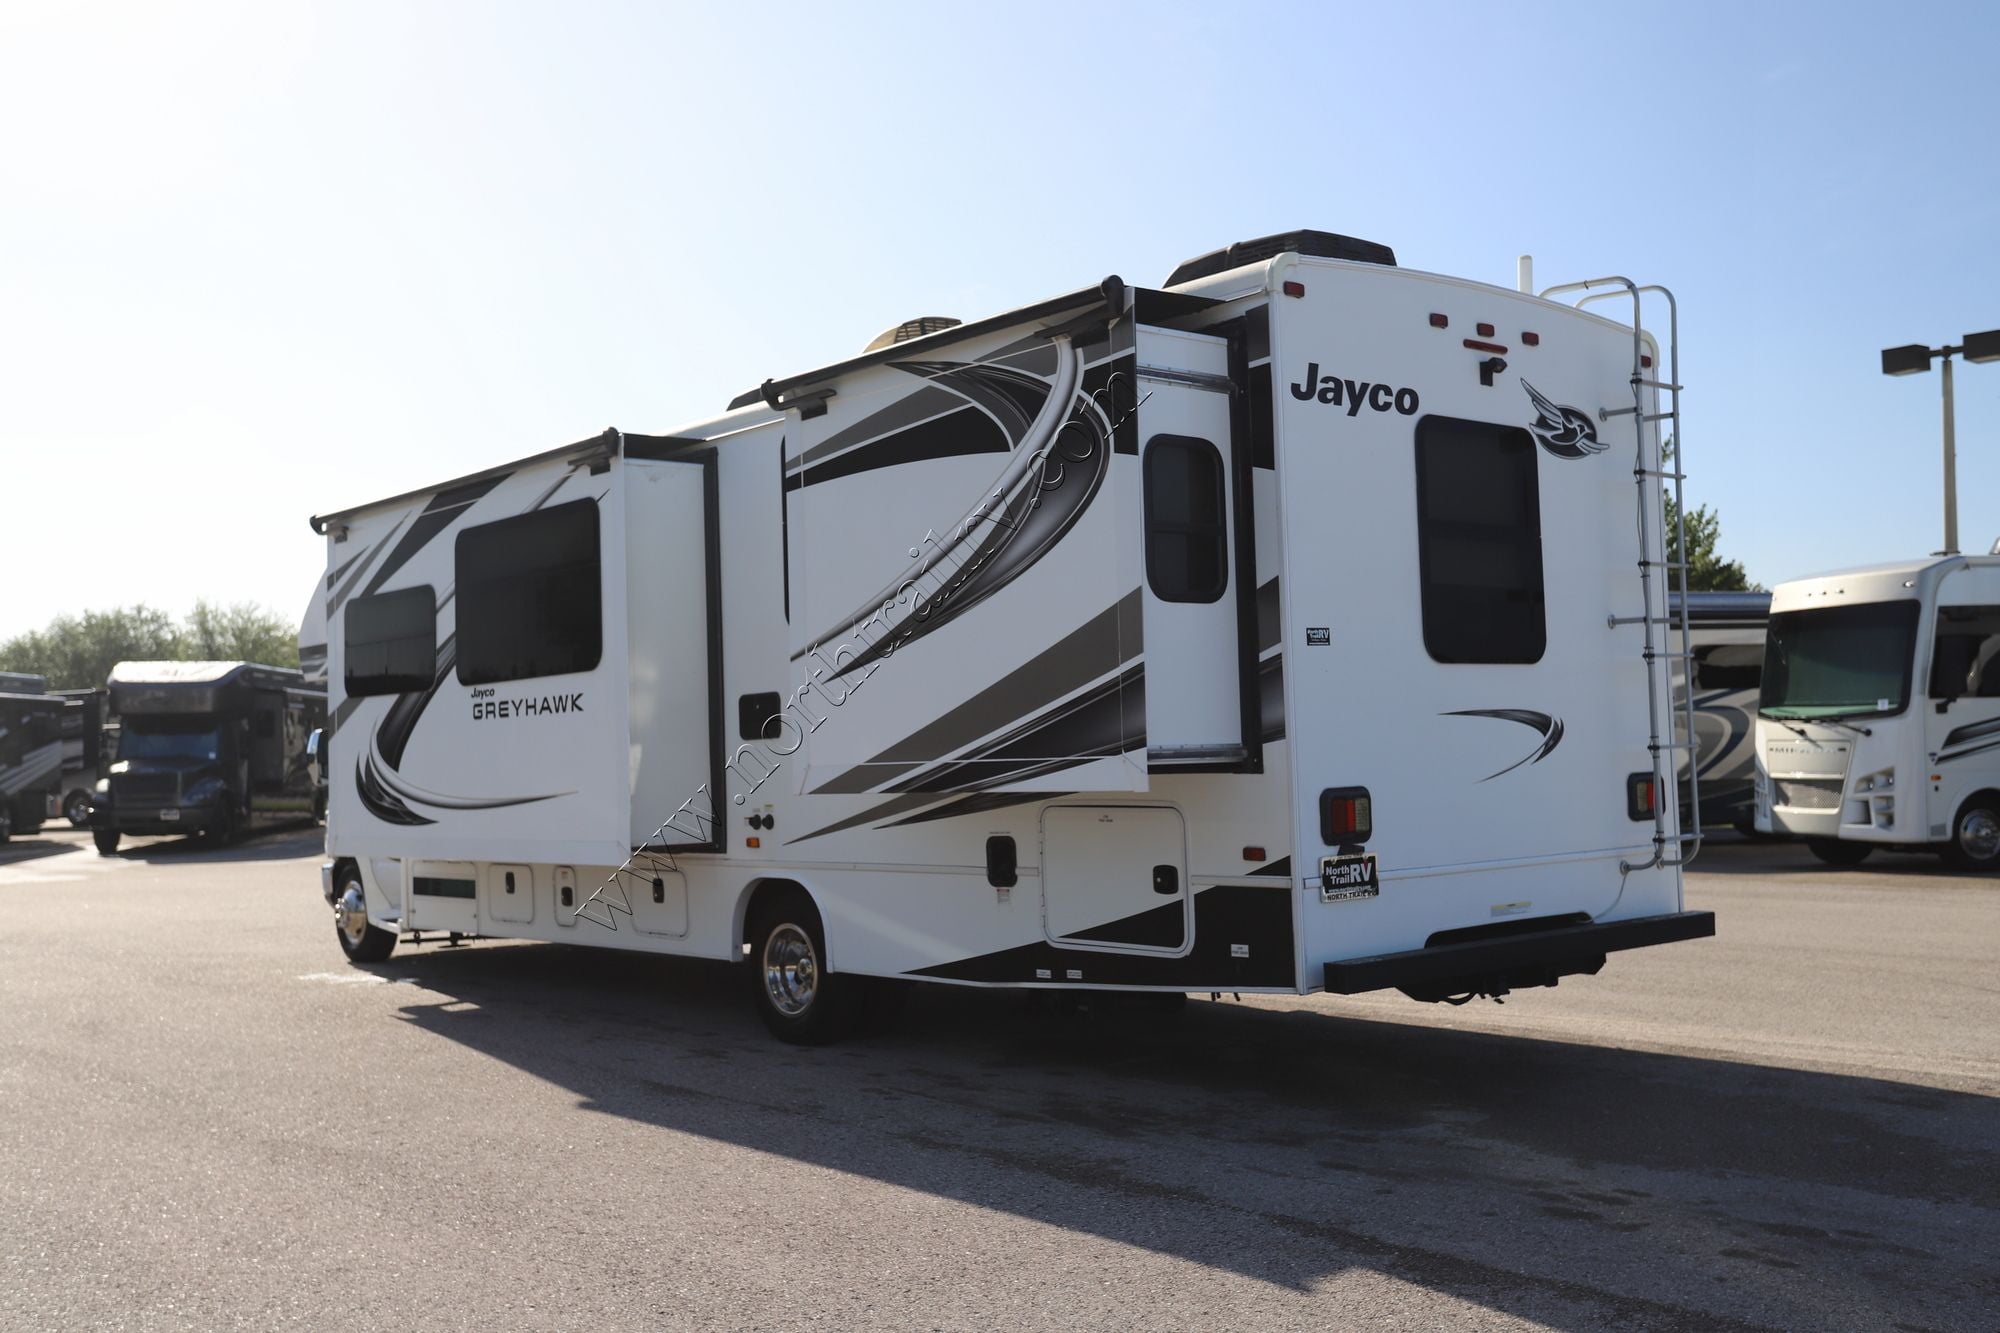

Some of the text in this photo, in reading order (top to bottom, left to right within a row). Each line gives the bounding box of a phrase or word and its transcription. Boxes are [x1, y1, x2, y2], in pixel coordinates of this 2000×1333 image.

[1291, 363, 1419, 416] Jayco
[471, 688, 495, 699] Jayco
[472, 693, 584, 720] GREYHAWK
[1325, 865, 1349, 876] North
[1350, 862, 1372, 883] RV
[1330, 875, 1350, 885] Trail
[1327, 892, 1347, 901] NORTH
